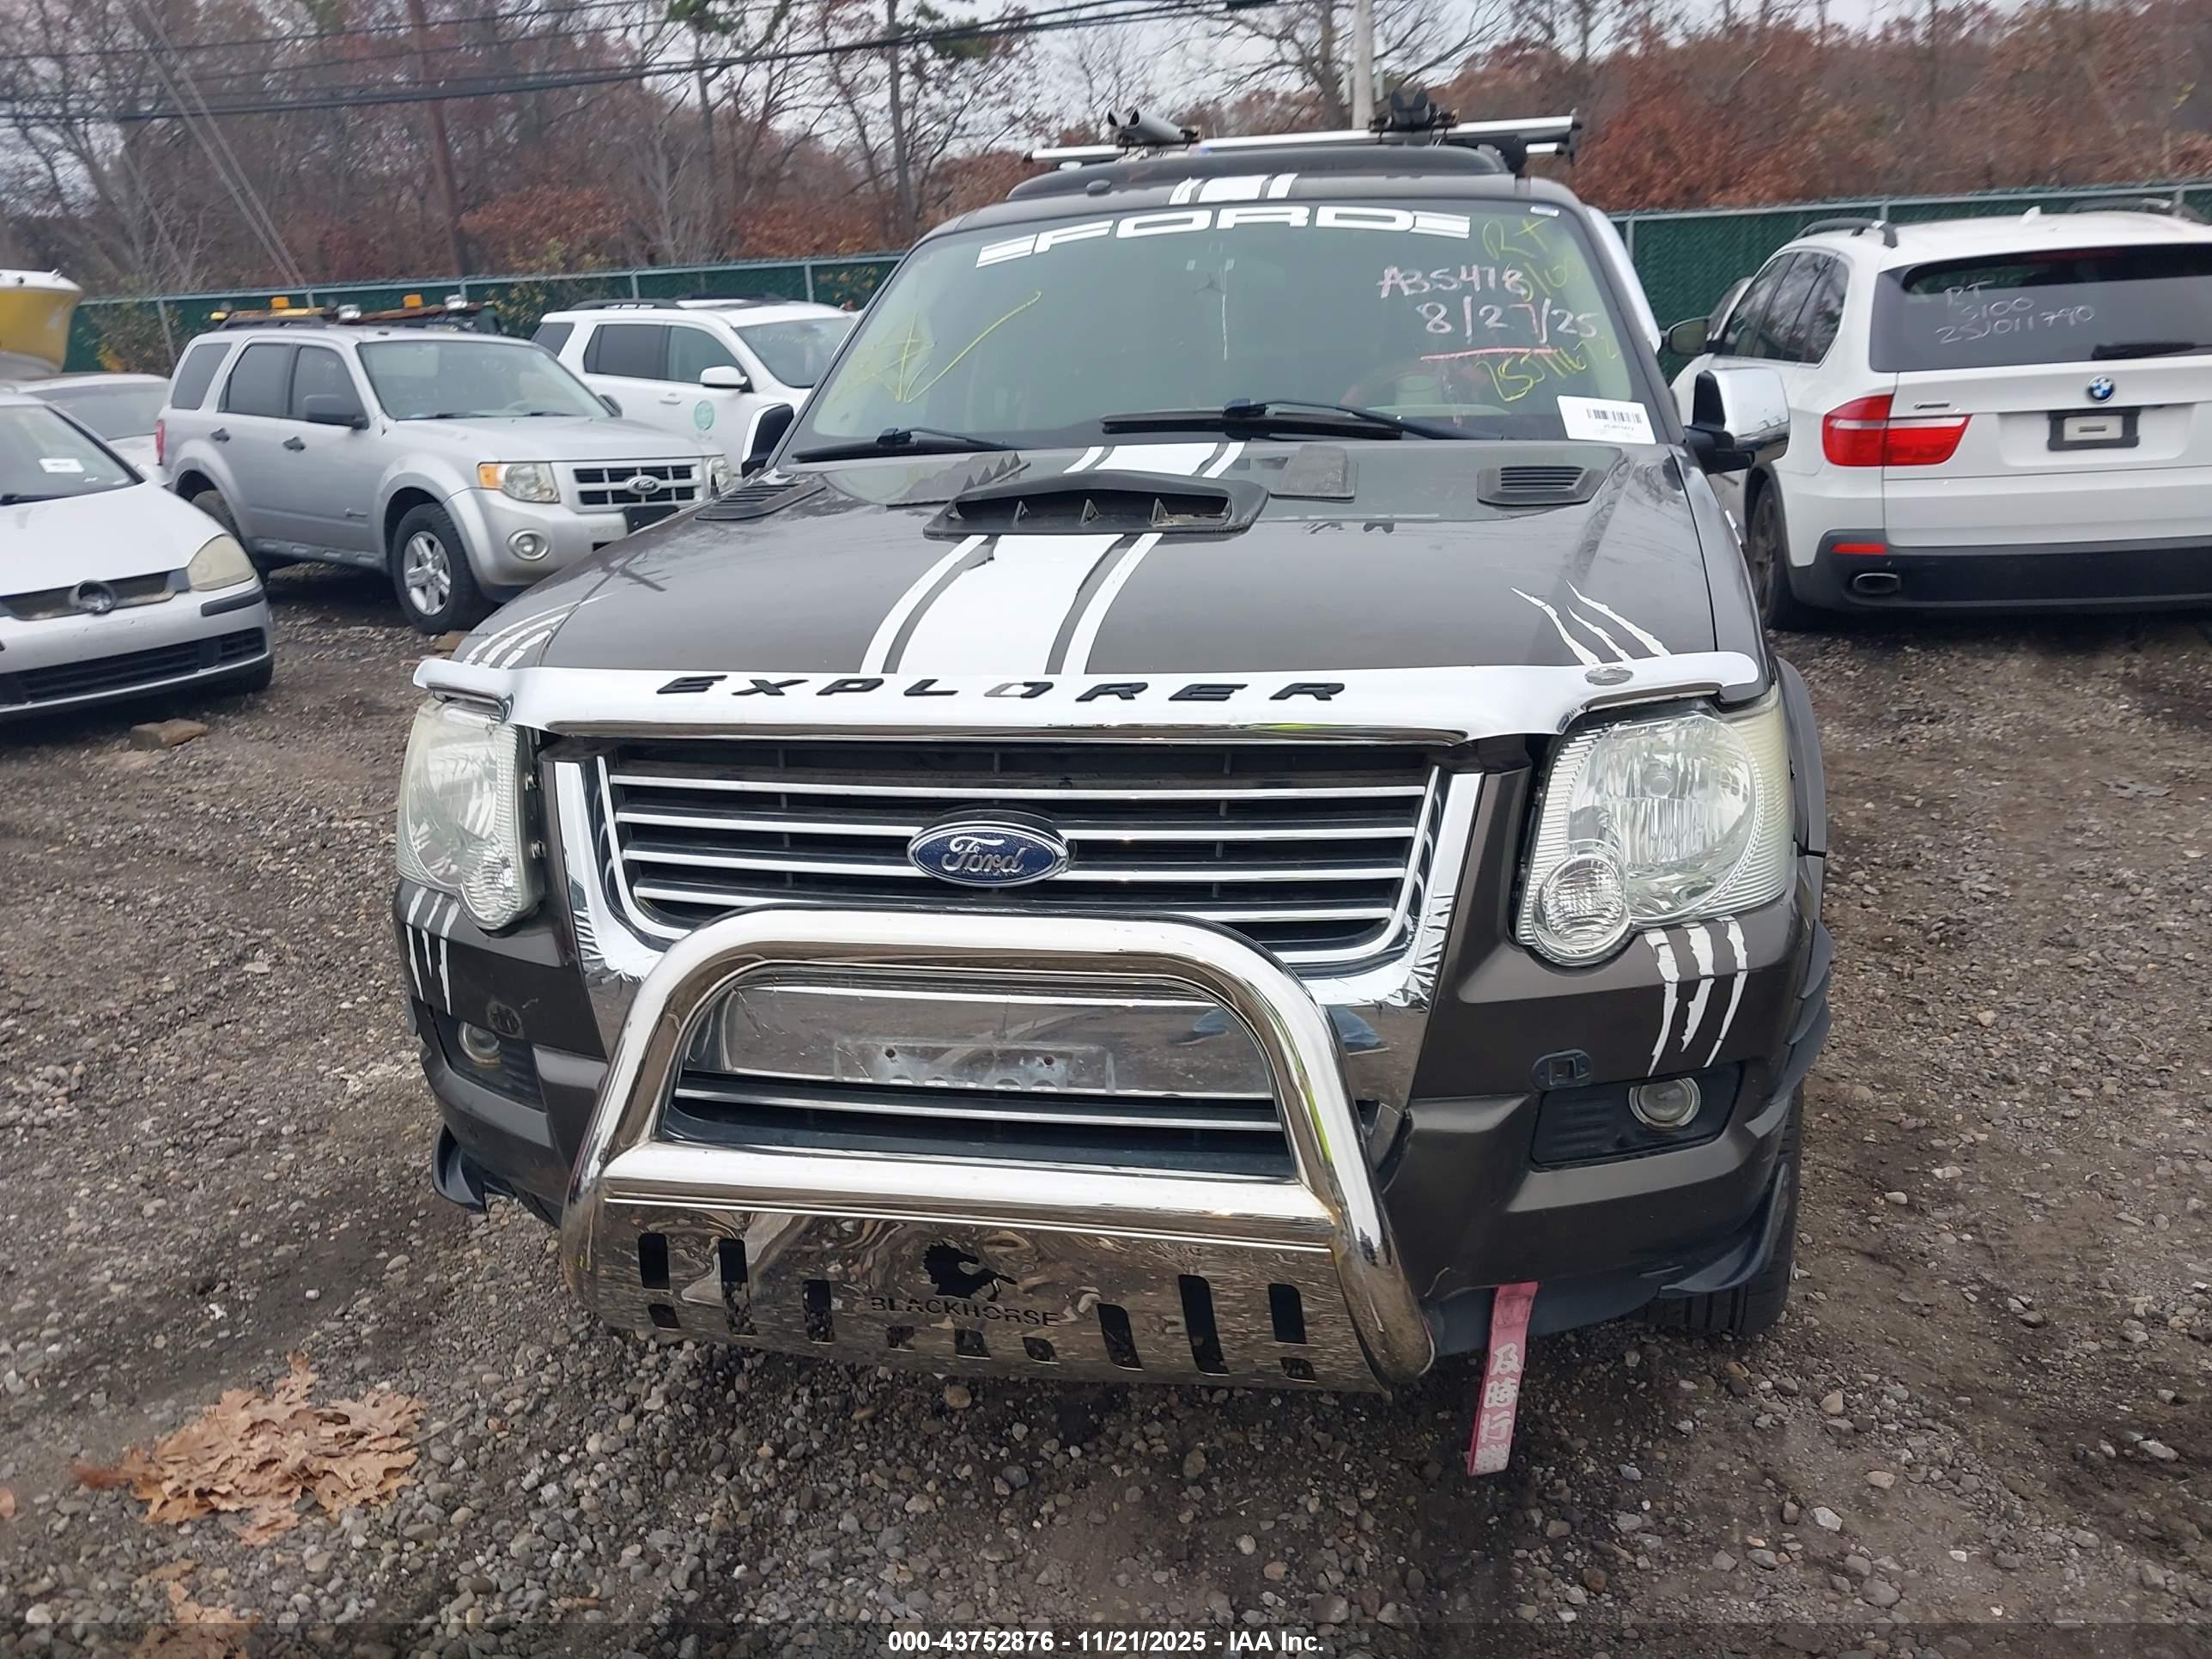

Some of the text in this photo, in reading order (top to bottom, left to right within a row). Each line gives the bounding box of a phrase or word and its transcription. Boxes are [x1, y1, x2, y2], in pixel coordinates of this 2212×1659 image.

[1034, 205, 1415, 254] FORD
[1416, 296, 1598, 343] 8/27/25
[655, 673, 1346, 702] EXPLORER
[941, 836, 1029, 873] Ford
[870, 1296, 1060, 1327] BLACKHORSE
